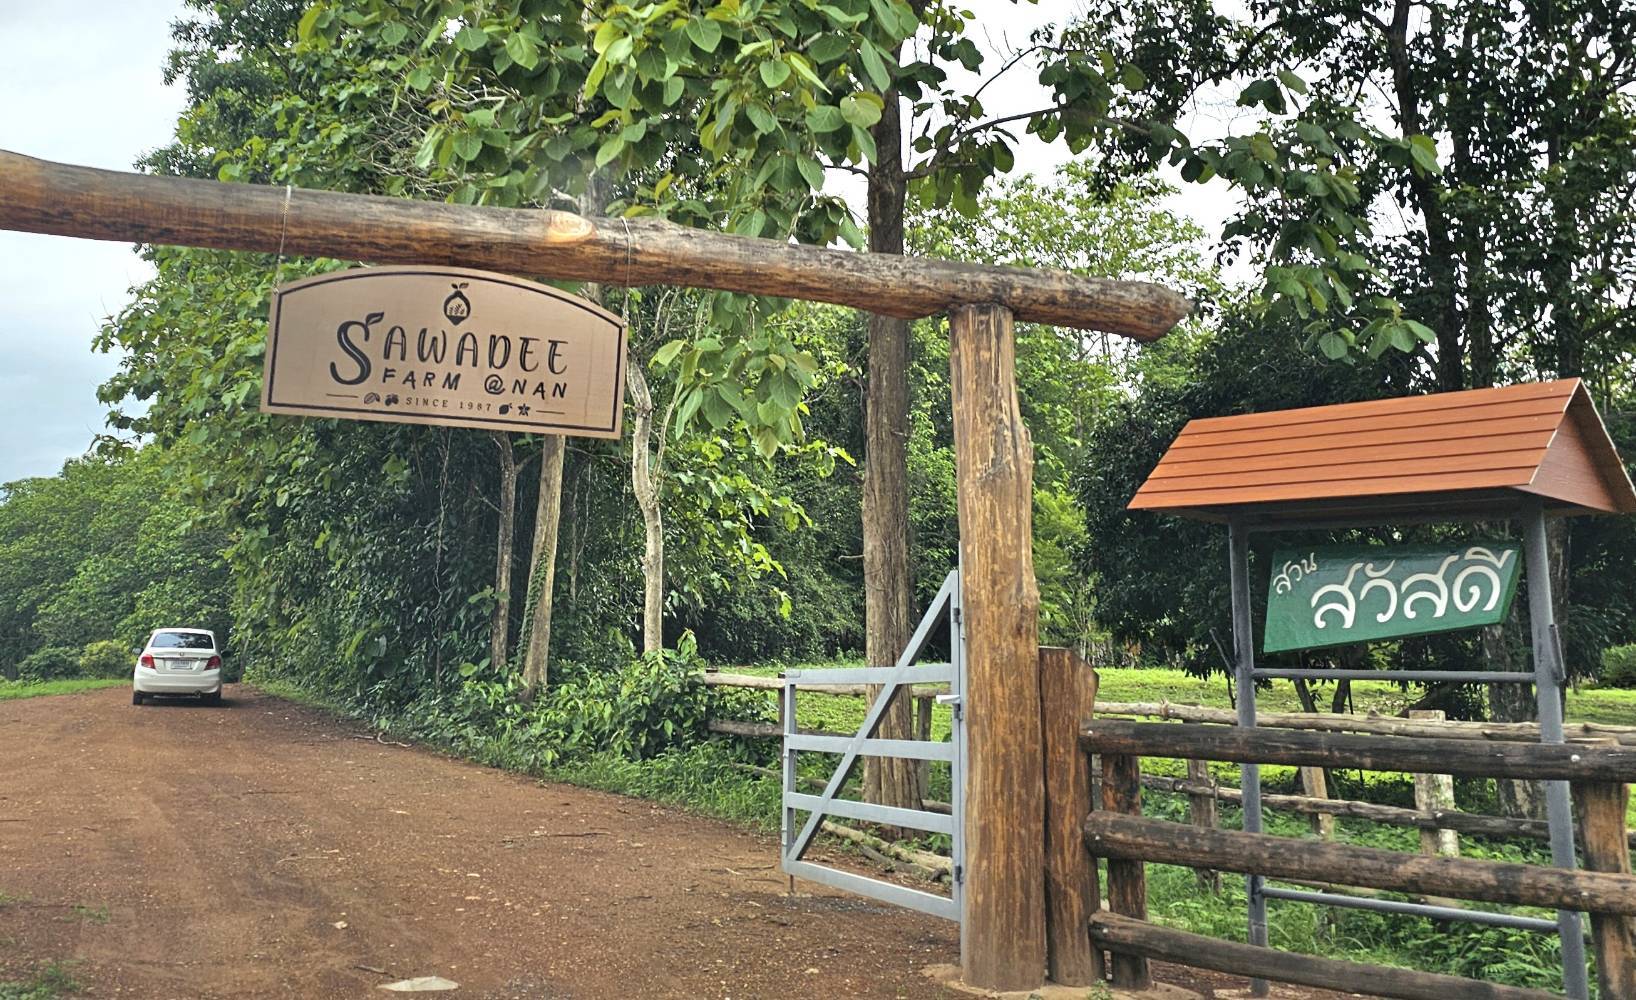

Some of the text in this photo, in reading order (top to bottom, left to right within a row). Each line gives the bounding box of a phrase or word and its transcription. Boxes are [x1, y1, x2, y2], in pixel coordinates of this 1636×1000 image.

[329, 314, 569, 385] SAWADEE
[382, 367, 568, 400] FARM @NAN
[405, 396, 492, 412] SINCE 1987
[1273, 552, 1318, 595] สวน
[1310, 546, 1514, 629] สวัสดี
